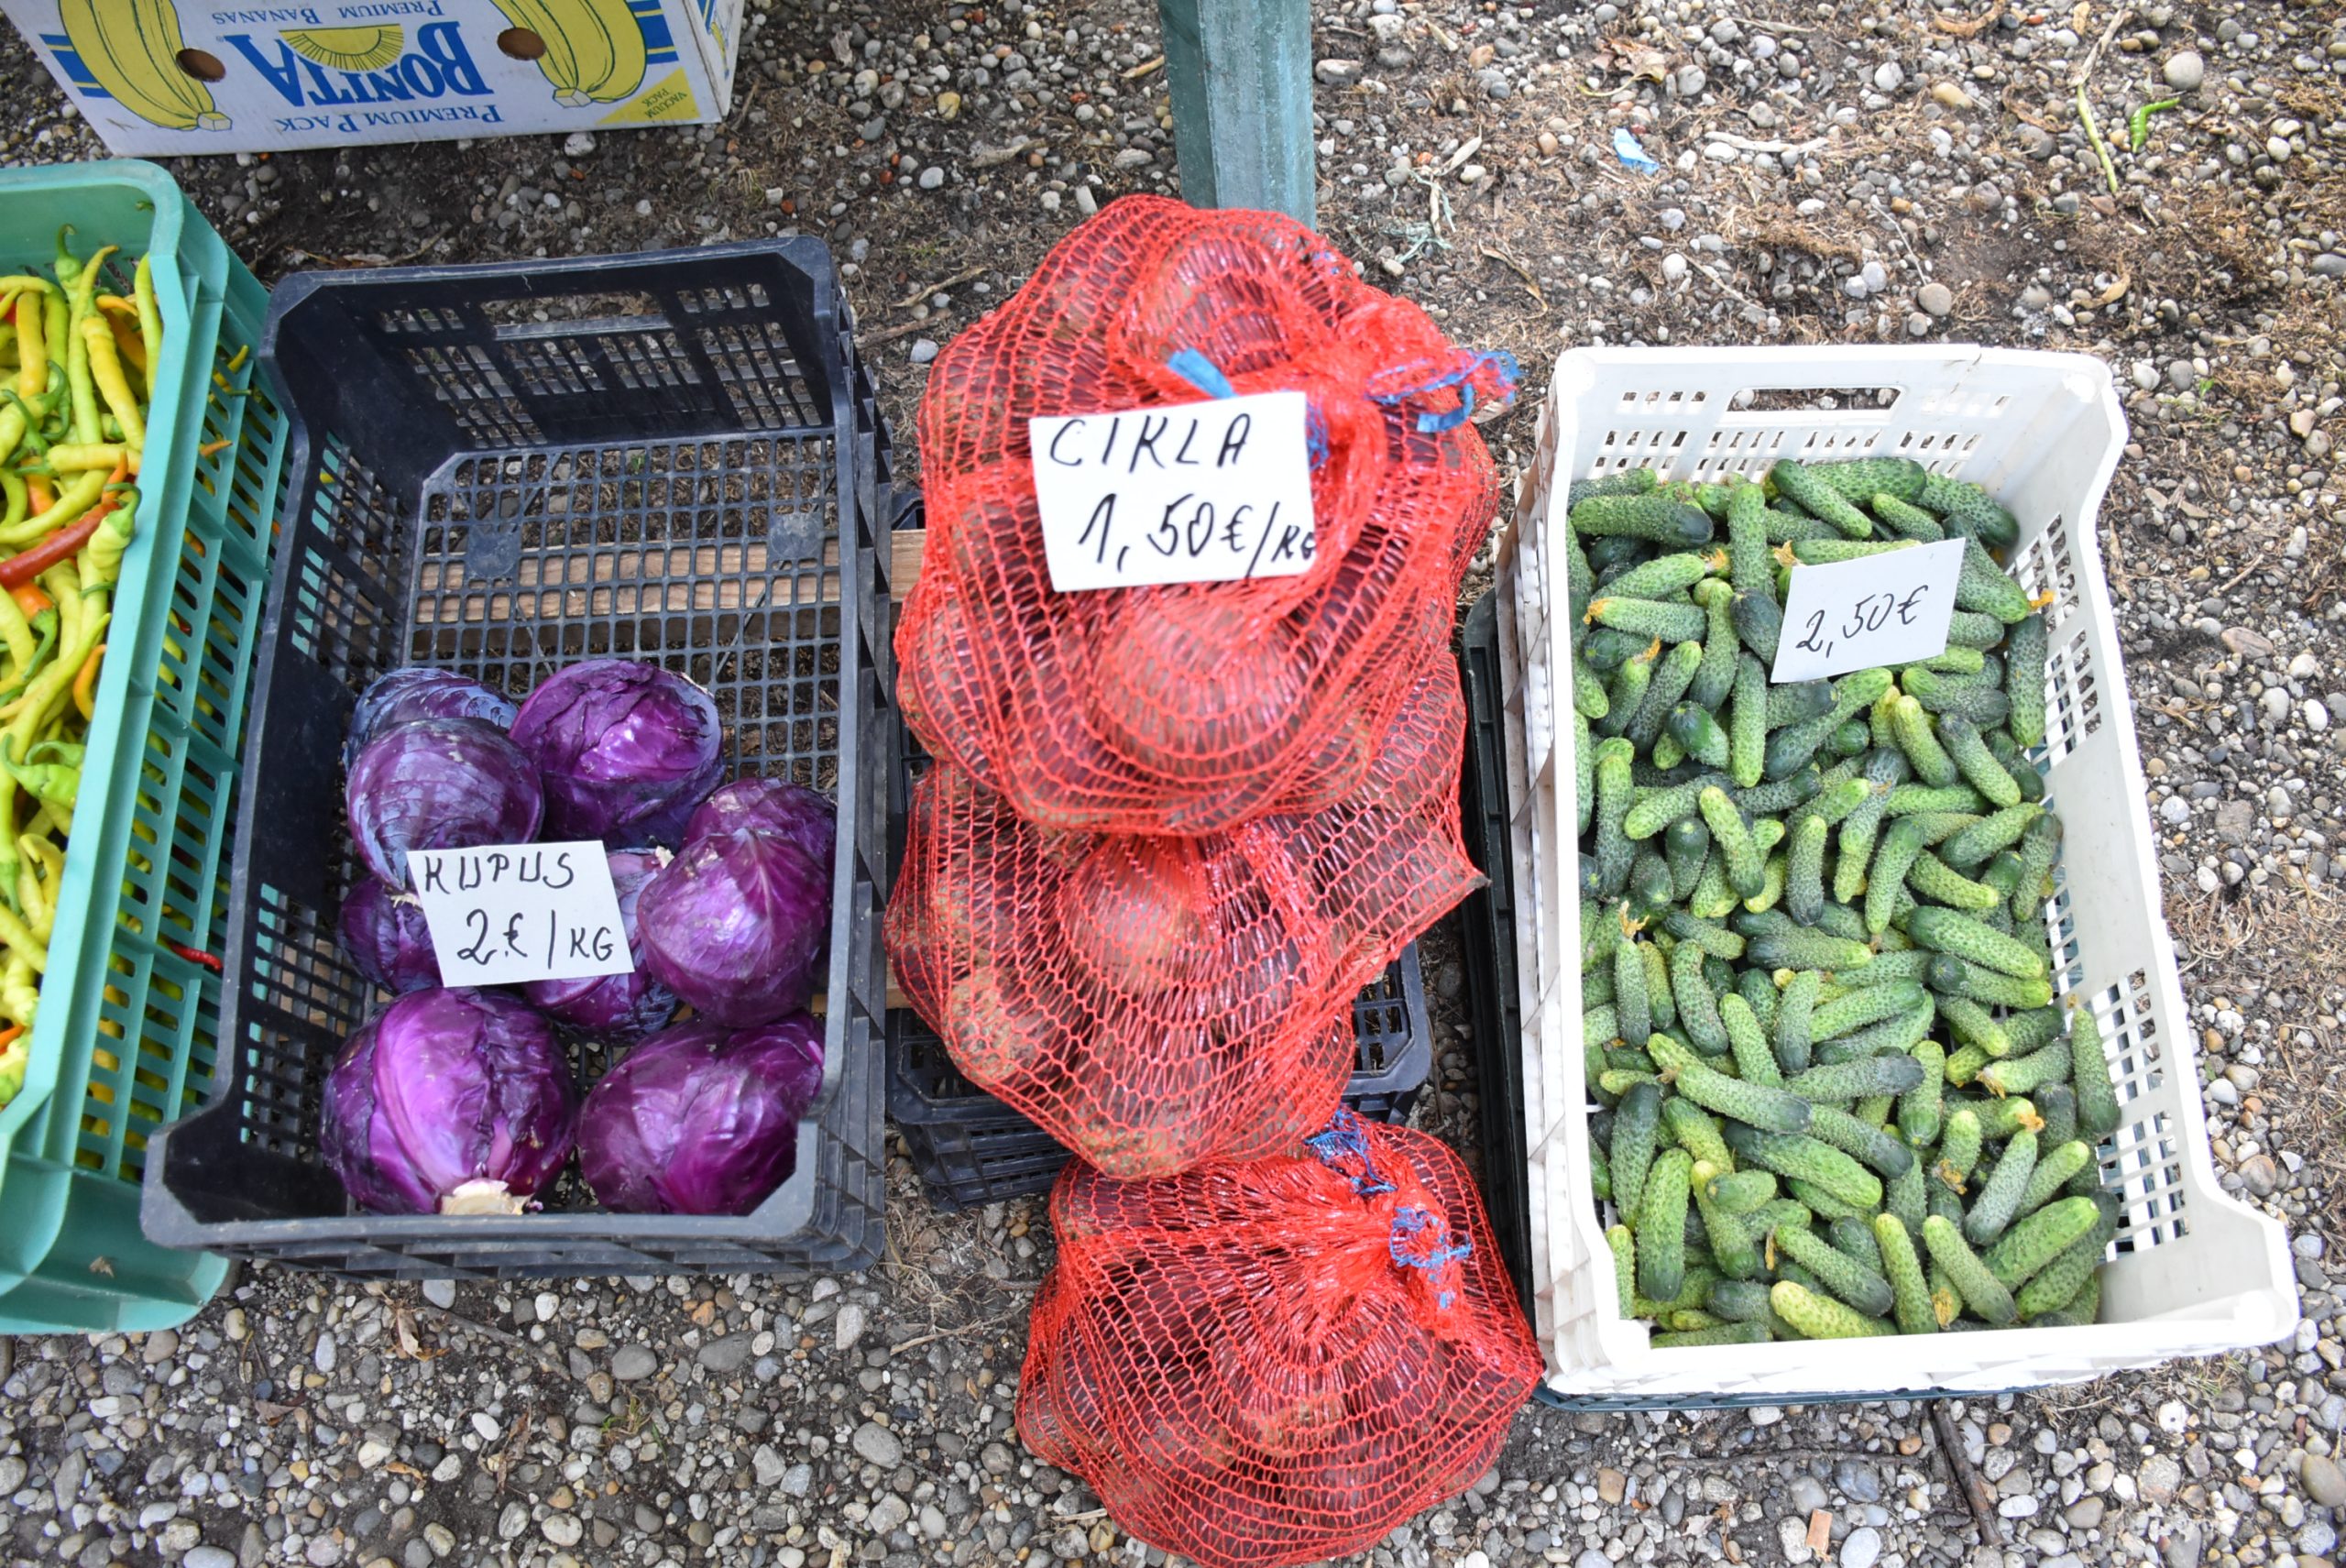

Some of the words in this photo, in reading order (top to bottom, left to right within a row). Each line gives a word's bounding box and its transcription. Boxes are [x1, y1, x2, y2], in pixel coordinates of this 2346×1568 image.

[212, 7, 323, 26] BANANAS
[339, 0, 445, 18] PREMIUM
[224, 20, 495, 107] BONITA
[641, 87, 671, 108] PACK
[644, 91, 687, 119] VACUUM
[275, 113, 362, 134] PACK
[366, 104, 505, 127] PREMIUM
[1049, 412, 1252, 474] CIKLA
[1795, 584, 1929, 659] 2,50€
[424, 850, 575, 895] KUPUS
